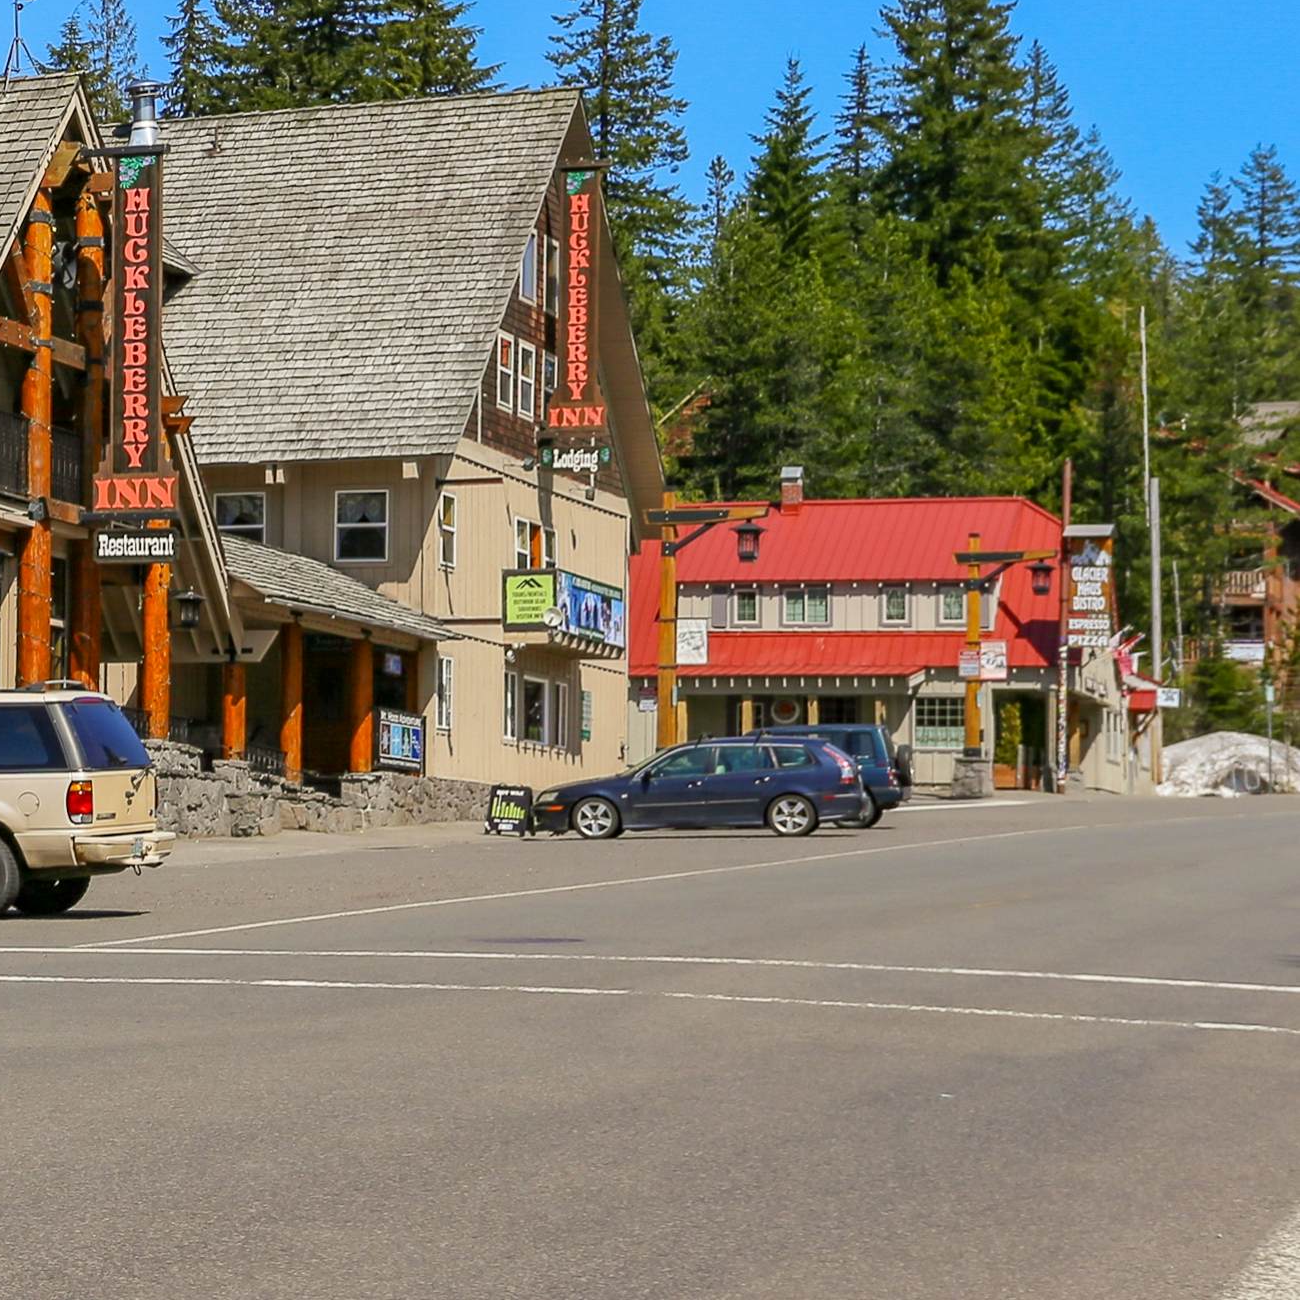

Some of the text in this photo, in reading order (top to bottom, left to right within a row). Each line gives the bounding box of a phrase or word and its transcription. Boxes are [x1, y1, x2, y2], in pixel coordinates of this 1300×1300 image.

[568, 193, 590, 401] HUCKLEBERRY
[122, 187, 150, 468] HUCKLEBERRY
[548, 406, 604, 428] INN
[552, 448, 599, 473] Lodging
[95, 477, 176, 510] INN
[98, 533, 175, 558] Restaurant
[1072, 566, 1108, 583] GLACIER
[1073, 596, 1105, 611] BISTRO
[1068, 618, 1110, 630] ESPRESSO
[1068, 634, 1108, 646] PIZZA
